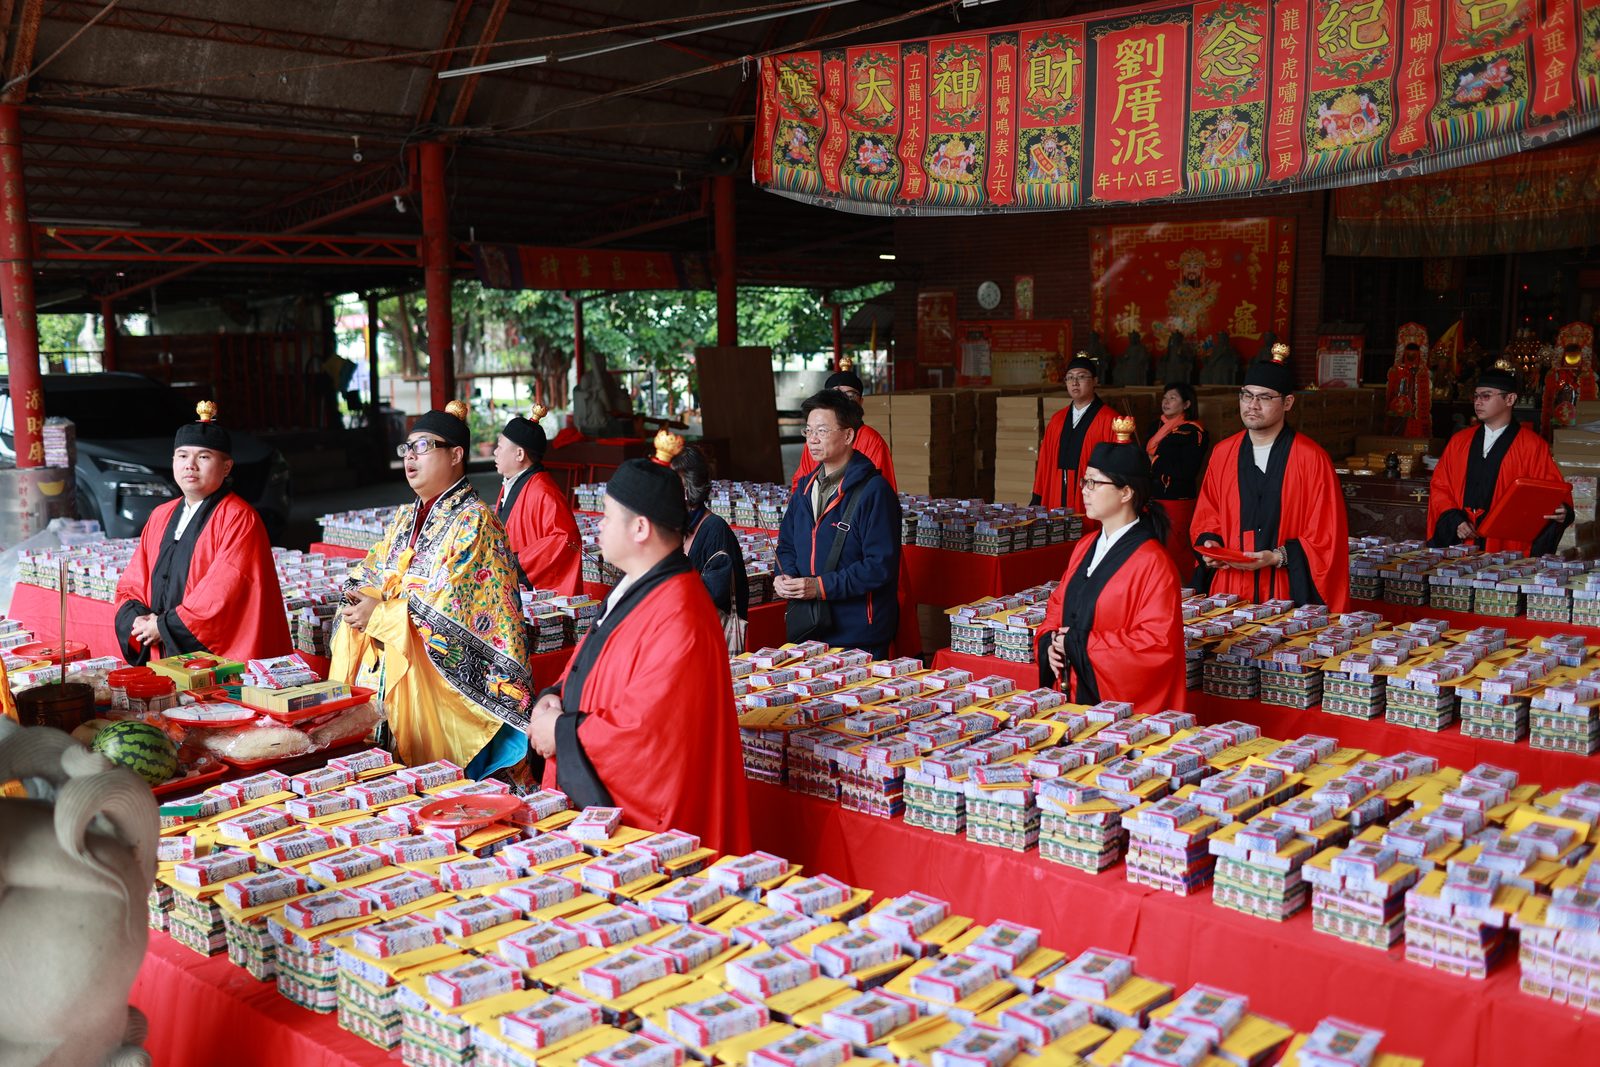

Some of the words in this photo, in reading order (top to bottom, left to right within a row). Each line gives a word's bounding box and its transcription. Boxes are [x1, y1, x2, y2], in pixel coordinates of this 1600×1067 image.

[902, 63, 921, 193] 五龍吐水洗金壇
[1275, 9, 1300, 173] 龍吟虎嘯通三界
